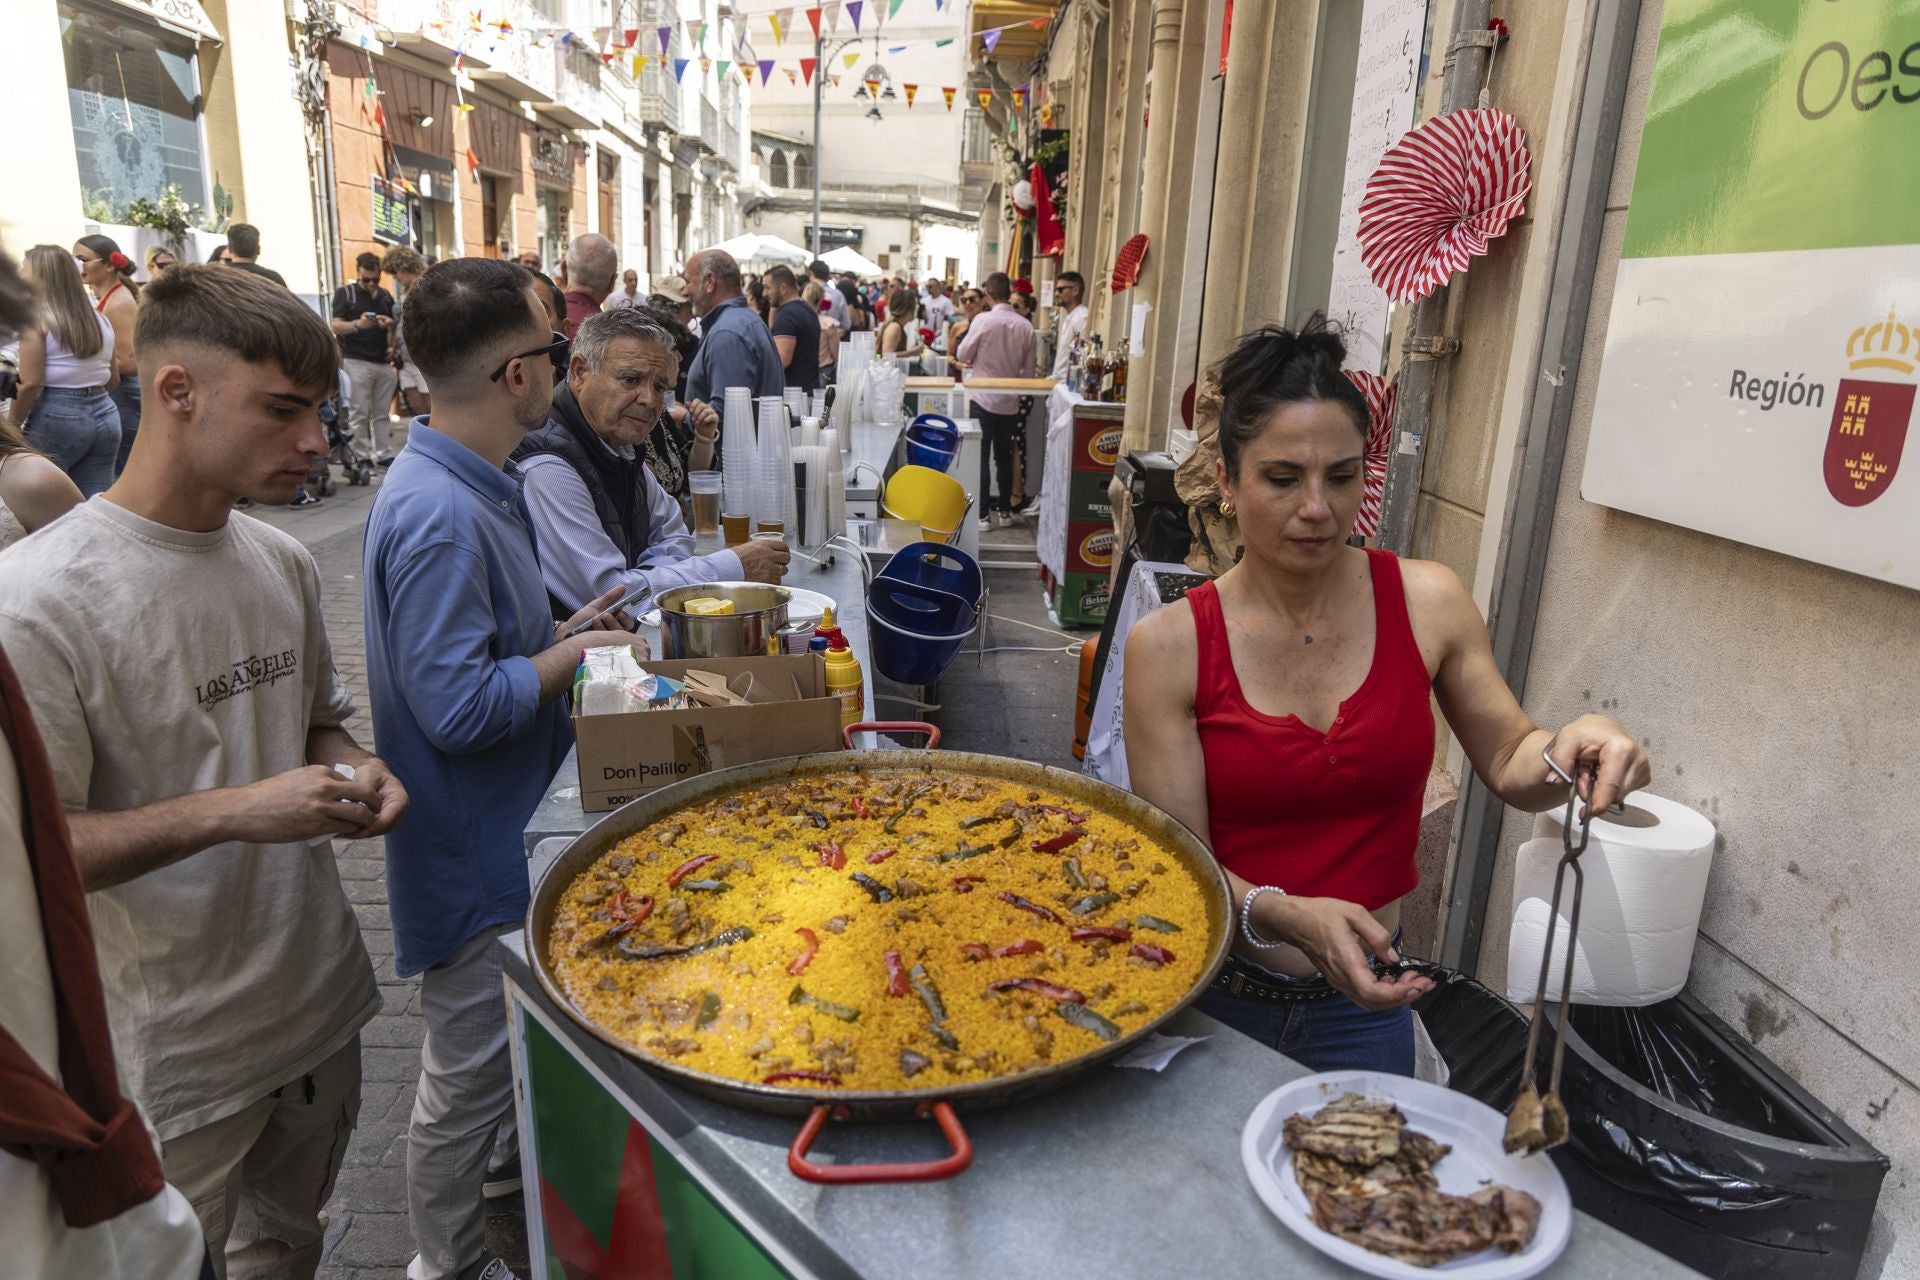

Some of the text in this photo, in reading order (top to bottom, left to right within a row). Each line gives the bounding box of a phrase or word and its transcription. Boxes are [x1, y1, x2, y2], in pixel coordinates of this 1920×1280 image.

[1797, 41, 1920, 120] Oes
[1729, 369, 1825, 411] Región
[195, 649, 297, 704] LOS ANGELES
[604, 767, 636, 780] Don
[606, 795, 634, 806] 100%
